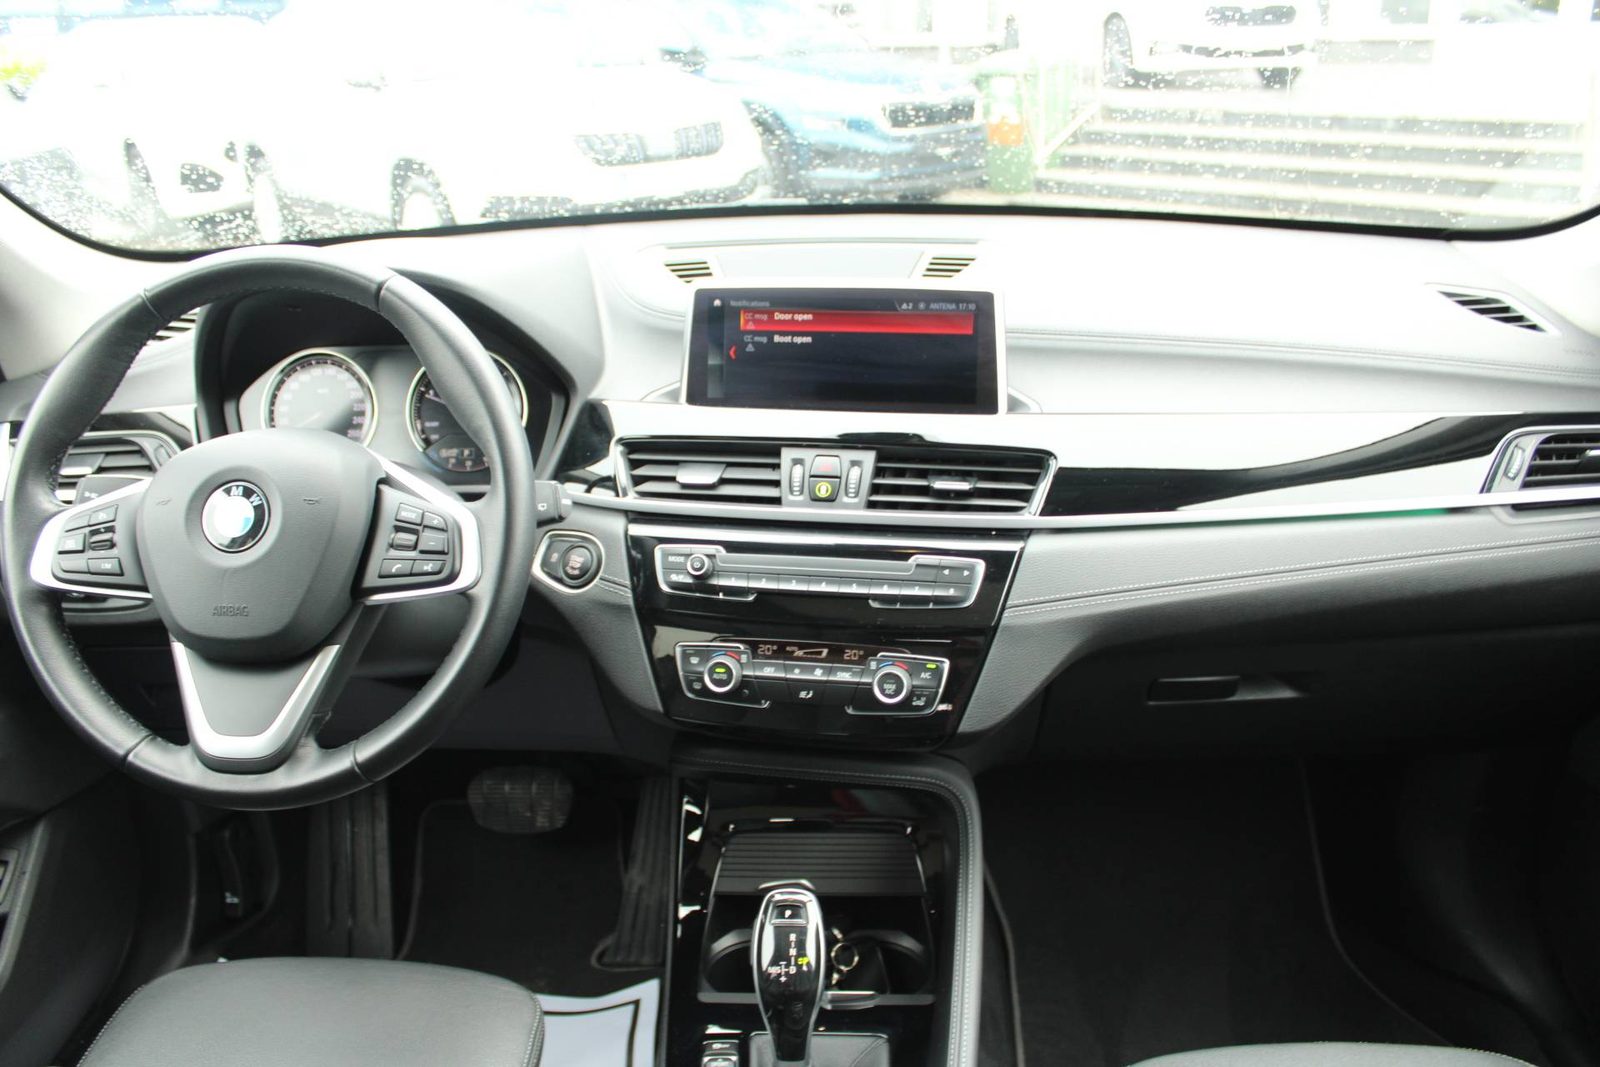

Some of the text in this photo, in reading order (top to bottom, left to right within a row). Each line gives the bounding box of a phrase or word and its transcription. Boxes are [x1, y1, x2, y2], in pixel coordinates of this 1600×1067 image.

[929, 302, 957, 310] ANTENA
[774, 312, 793, 320] Door
[794, 313, 813, 322] open
[773, 334, 792, 342] Boot
[793, 336, 812, 345] open
[212, 605, 249, 617] AIRBAG
[784, 909, 792, 918] P
[789, 933, 797, 942] R
[789, 948, 797, 956] N
[789, 966, 797, 975] D
